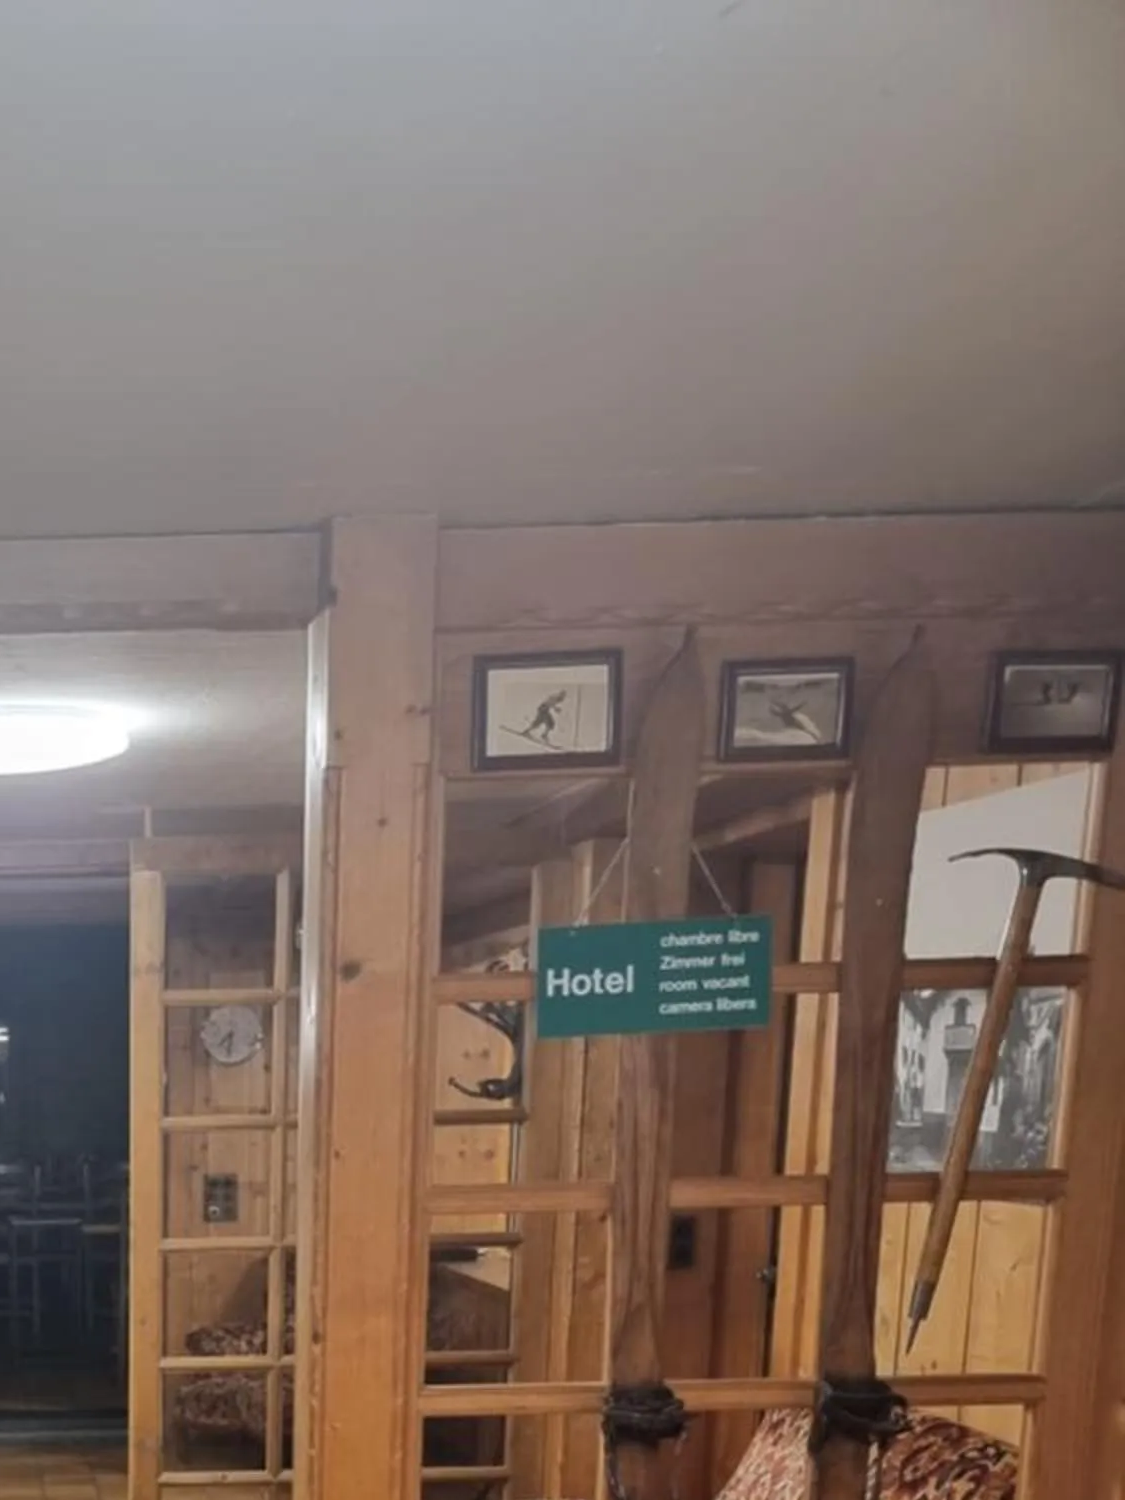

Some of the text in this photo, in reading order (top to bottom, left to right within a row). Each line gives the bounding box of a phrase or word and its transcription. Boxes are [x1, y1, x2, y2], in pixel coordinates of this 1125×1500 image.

[660, 929, 759, 948] chambre libre
[659, 952, 745, 970] Zimmer frei
[546, 964, 635, 997] Hotel
[659, 974, 750, 992] room vacant
[659, 1002, 713, 1015] camera
